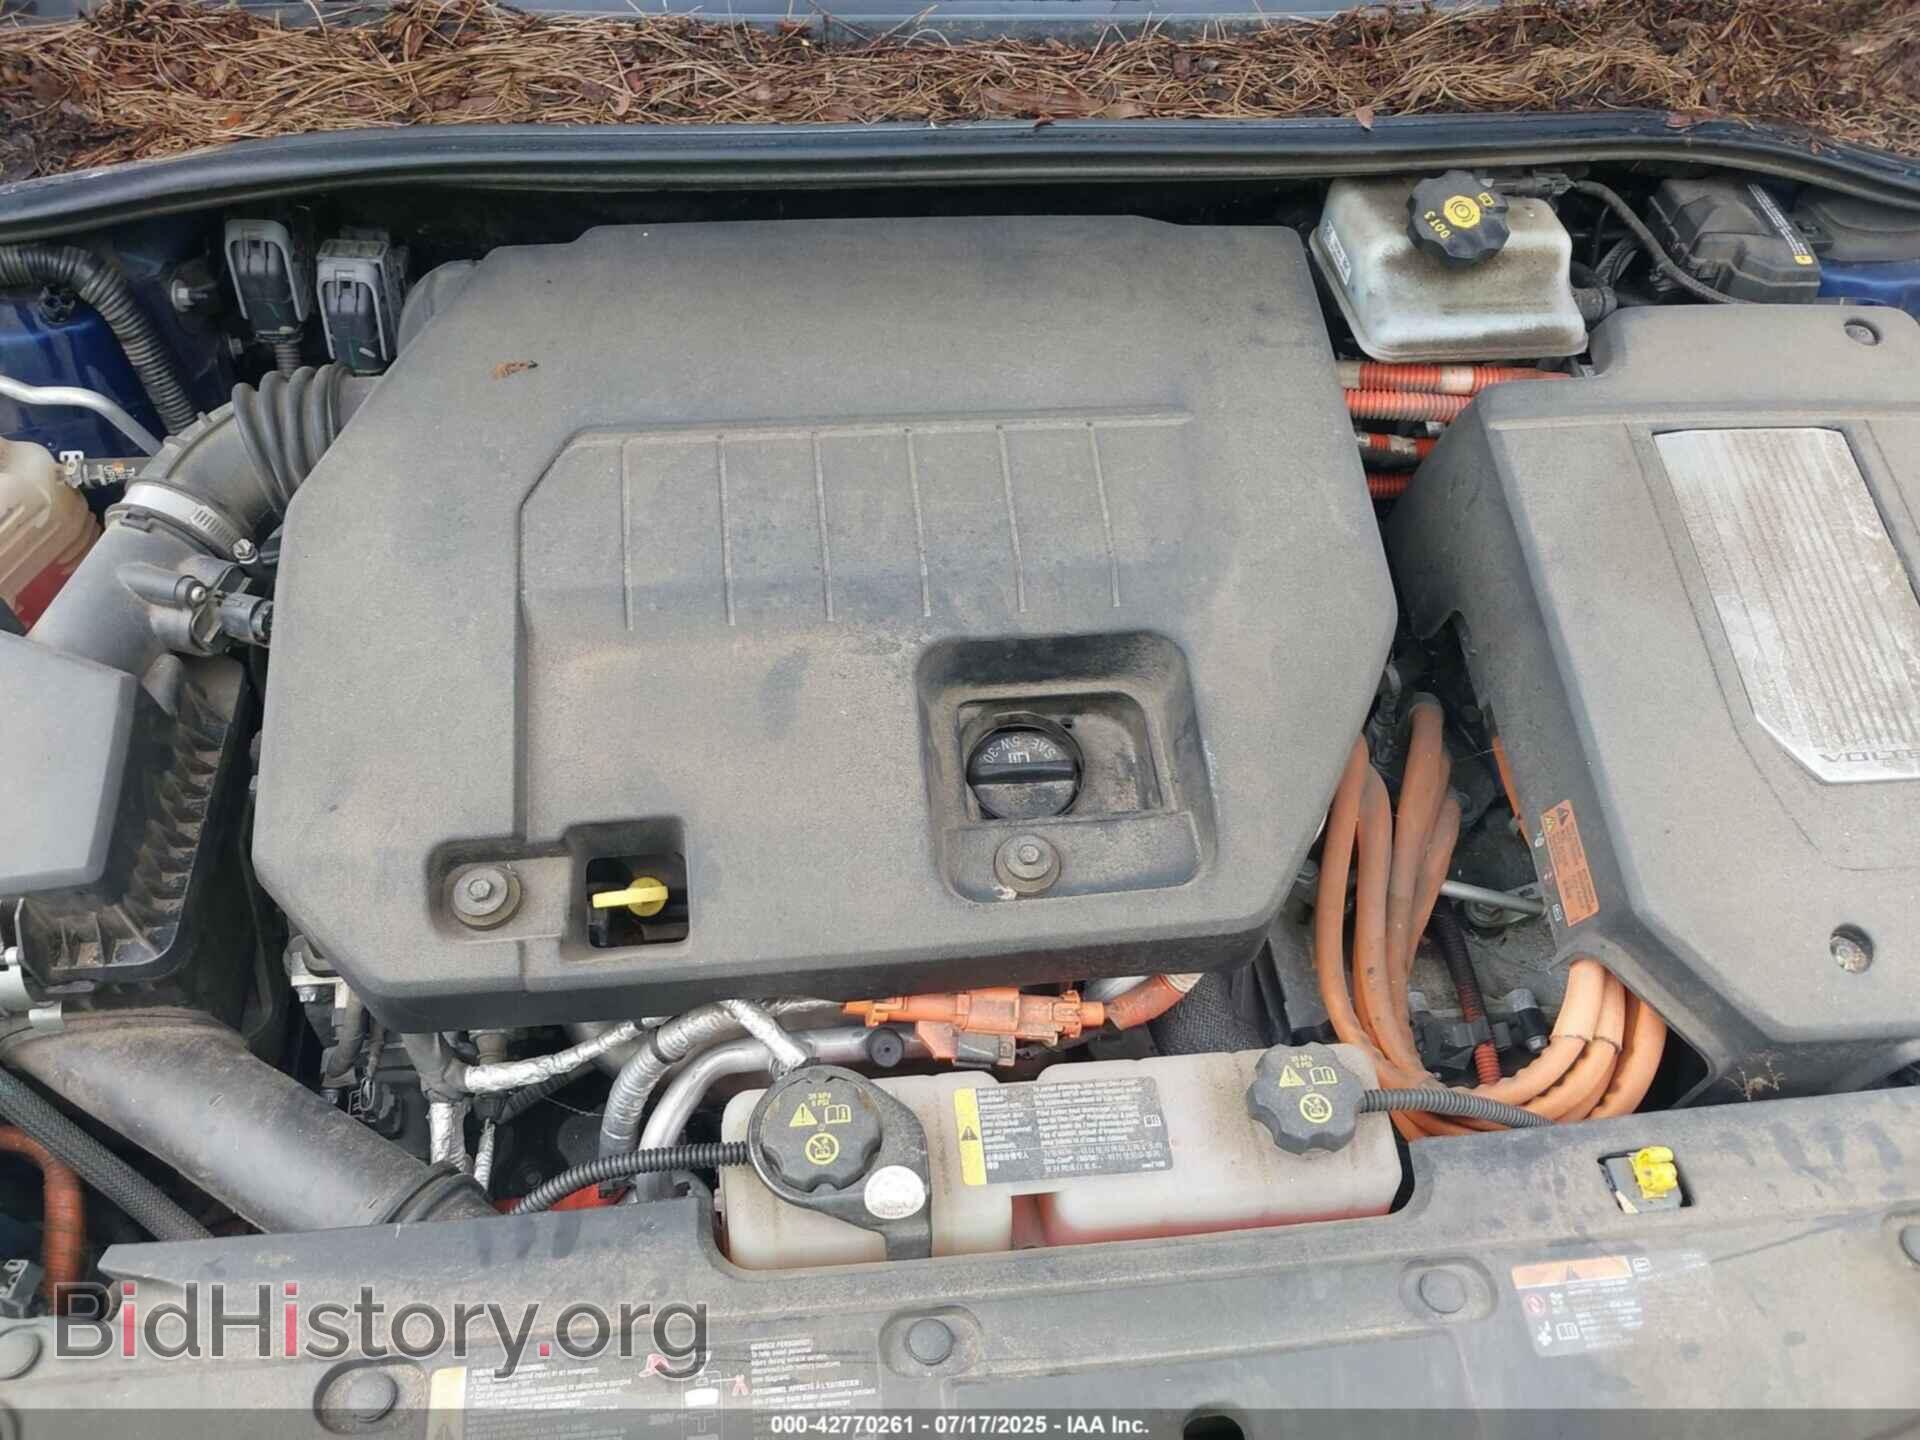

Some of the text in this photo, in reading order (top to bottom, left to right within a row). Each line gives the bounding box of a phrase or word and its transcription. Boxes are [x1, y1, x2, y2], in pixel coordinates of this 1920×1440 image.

[1424, 211, 1451, 239] DOT 3
[983, 735, 1057, 764] SAE 5W-30
